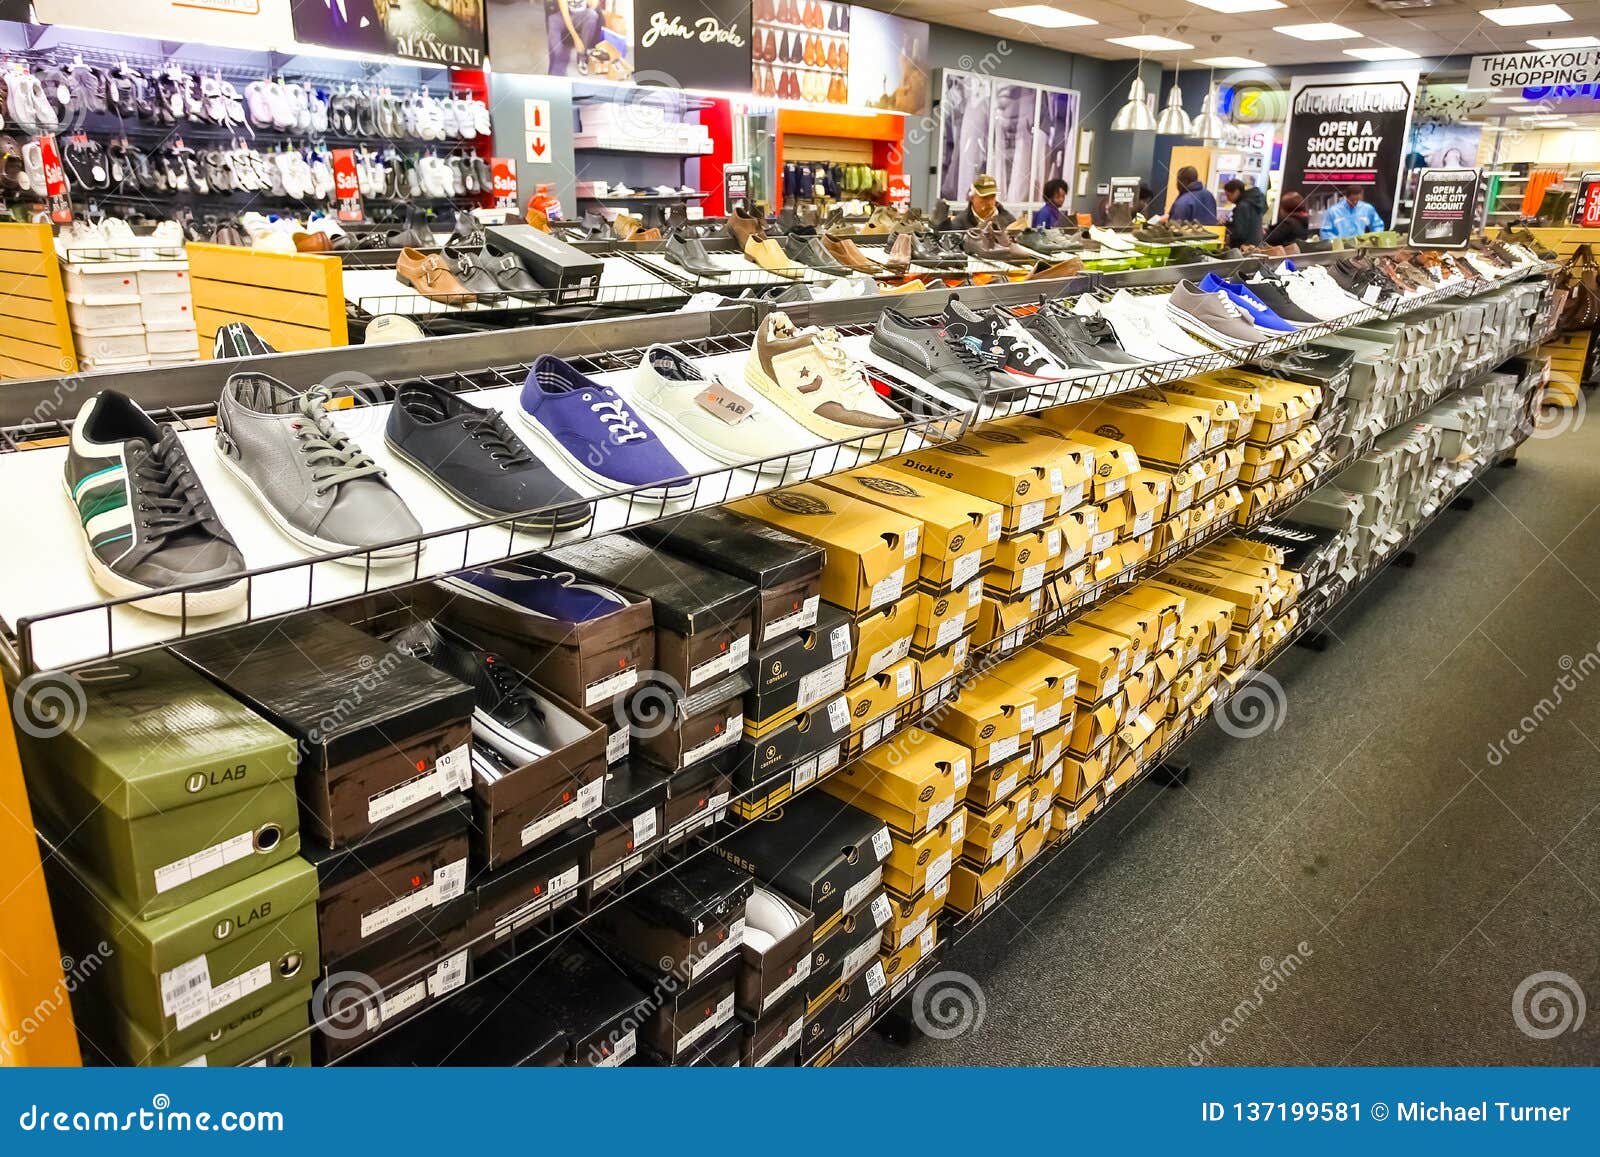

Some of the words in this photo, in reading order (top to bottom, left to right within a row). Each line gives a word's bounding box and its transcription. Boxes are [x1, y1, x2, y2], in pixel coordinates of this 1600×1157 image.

[642, 11, 694, 47] John
[396, 36, 481, 66] MANCINI
[1481, 51, 1589, 72] THANK-YOU
[1490, 69, 1588, 87] SHOPPING
[1319, 121, 1358, 136] OPEN
[1361, 120, 1373, 135] A
[1307, 137, 1345, 152] SHOE
[1347, 136, 1383, 152] CITY
[1307, 153, 1377, 168] ACCOUNT
[494, 175, 516, 191] Sale
[1432, 186, 1455, 194] OPEN
[1424, 194, 1448, 202] SHOE
[1449, 194, 1467, 202] CITY
[902, 459, 954, 479] Dickies
[828, 703, 837, 714] 07
[440, 756, 451, 767] 10
[210, 765, 247, 786] LAB
[699, 840, 756, 874] NVERSE
[551, 877, 563, 890] 11
[237, 901, 272, 929] LAB
